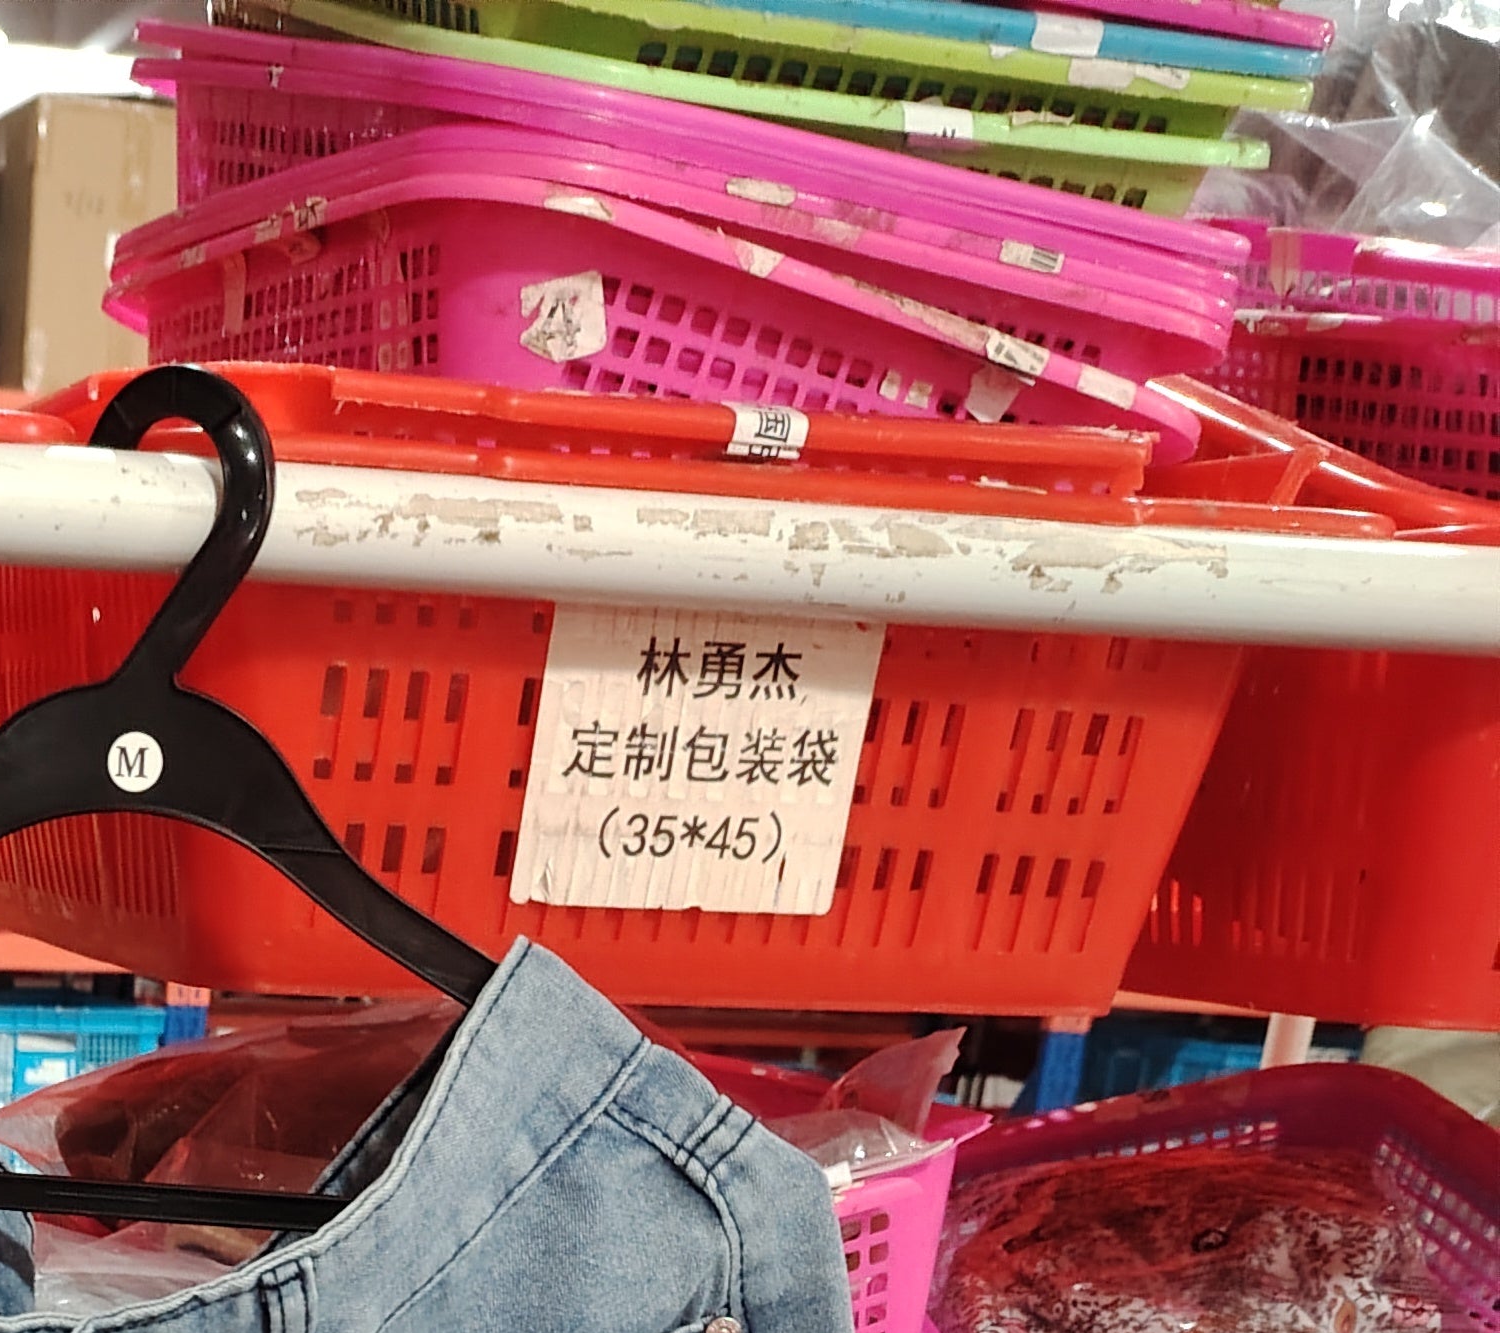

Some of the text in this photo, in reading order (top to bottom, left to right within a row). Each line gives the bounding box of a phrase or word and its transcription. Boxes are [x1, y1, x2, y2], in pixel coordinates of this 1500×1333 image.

[636, 636, 804, 700] 林勇杰
[115, 745, 149, 779] M
[561, 719, 840, 787] 定制包装袋
